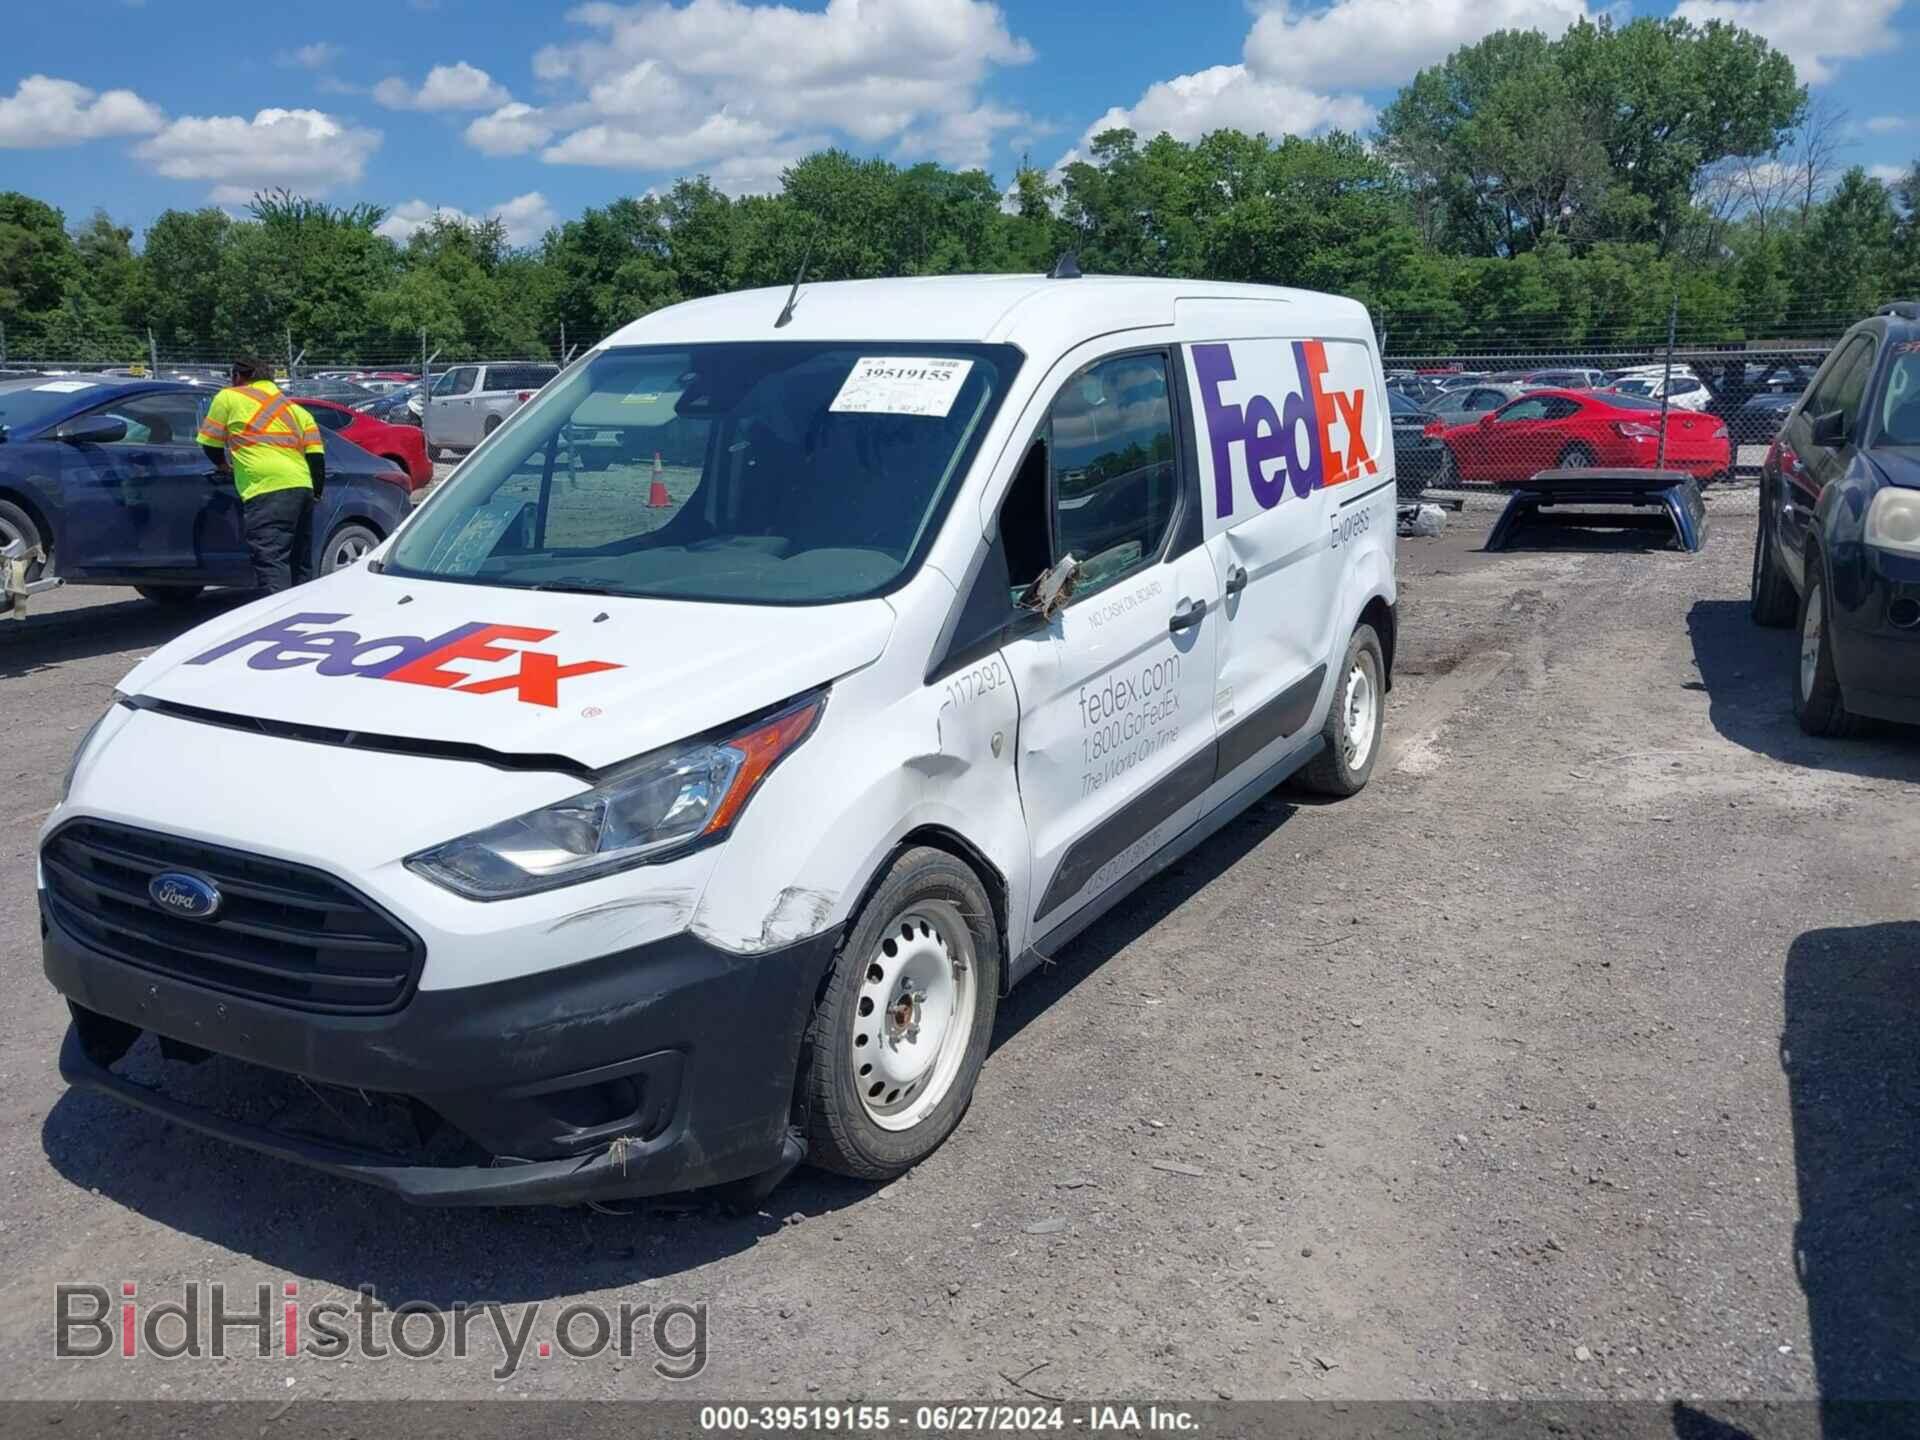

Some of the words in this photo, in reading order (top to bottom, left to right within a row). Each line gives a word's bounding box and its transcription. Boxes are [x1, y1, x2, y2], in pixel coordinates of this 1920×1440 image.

[1191, 338, 1377, 519] FedEx
[1330, 506, 1371, 552] Express
[1102, 599, 1126, 623] CASH
[182, 612, 626, 709] FedEx
[1079, 654, 1181, 729] fedex.com
[1081, 688, 1180, 766] 1.800.GoFedEx
[1081, 770, 1103, 798] The
[159, 880, 197, 910] Ford
